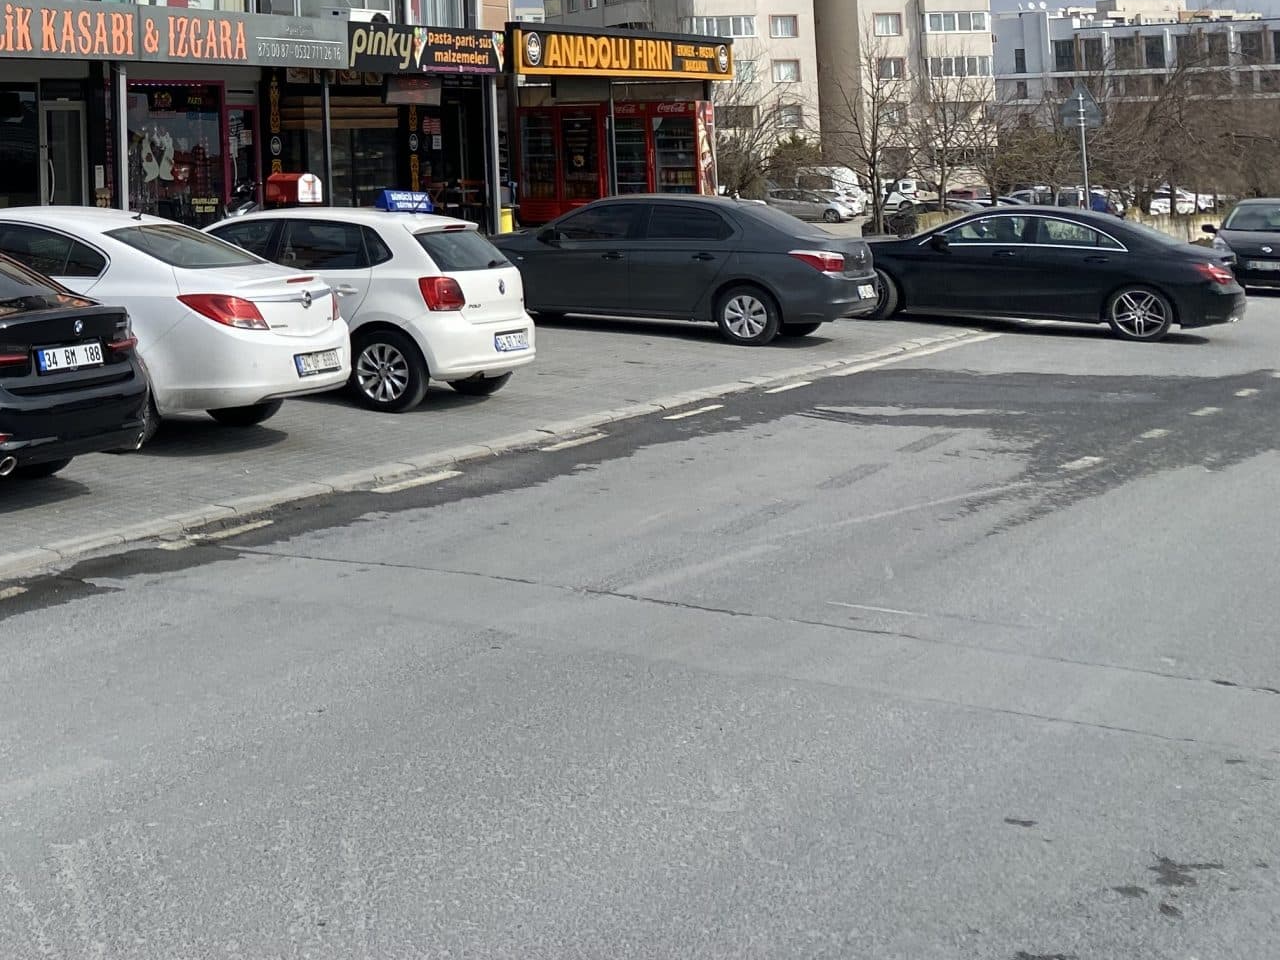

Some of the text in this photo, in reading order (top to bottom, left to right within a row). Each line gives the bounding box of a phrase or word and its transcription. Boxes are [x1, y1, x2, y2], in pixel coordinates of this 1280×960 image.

[40, 8, 136, 57] KASABI
[144, 18, 160, 54] &
[167, 15, 249, 61] IZGARA
[349, 25, 414, 70] pinky
[544, 34, 673, 70] ANADOLU FIRIN
[434, 49, 489, 65] malzemeleri
[44, 345, 101, 368] 34 BM 188
